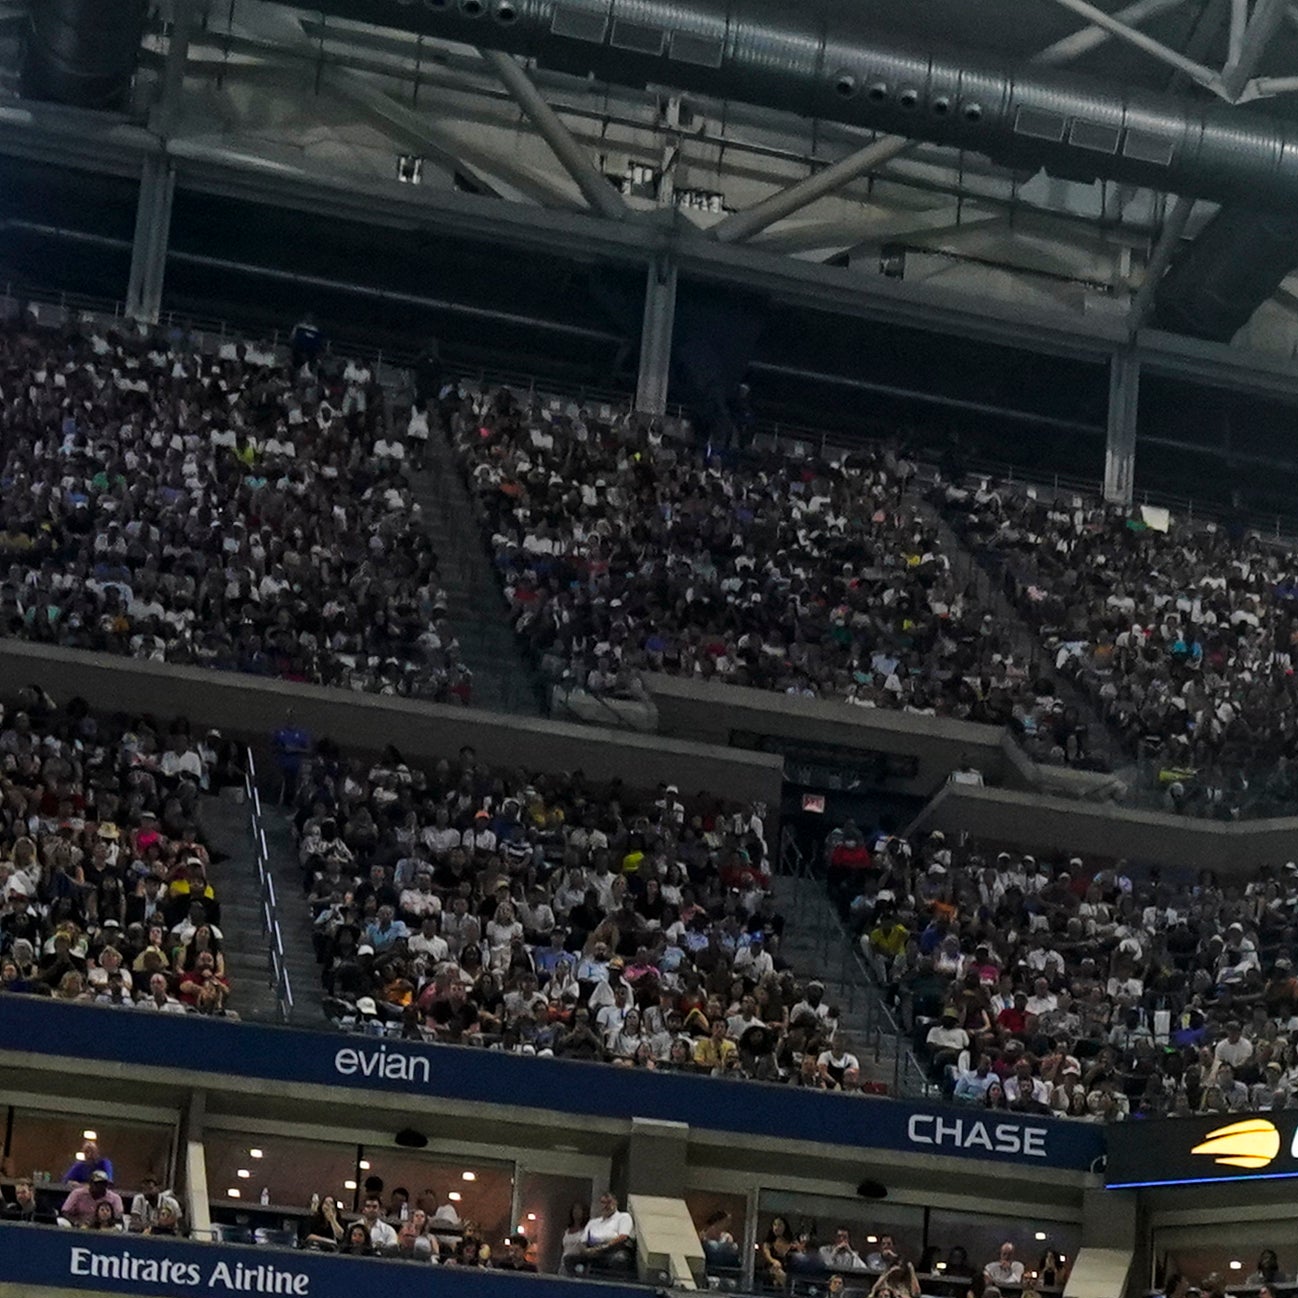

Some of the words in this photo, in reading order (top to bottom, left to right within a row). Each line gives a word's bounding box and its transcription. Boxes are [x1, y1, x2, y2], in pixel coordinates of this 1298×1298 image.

[335, 1046, 430, 1082] evian
[908, 1113, 1048, 1157] CHASE
[70, 1246, 201, 1286] Emirates
[208, 1260, 310, 1296] Airline
